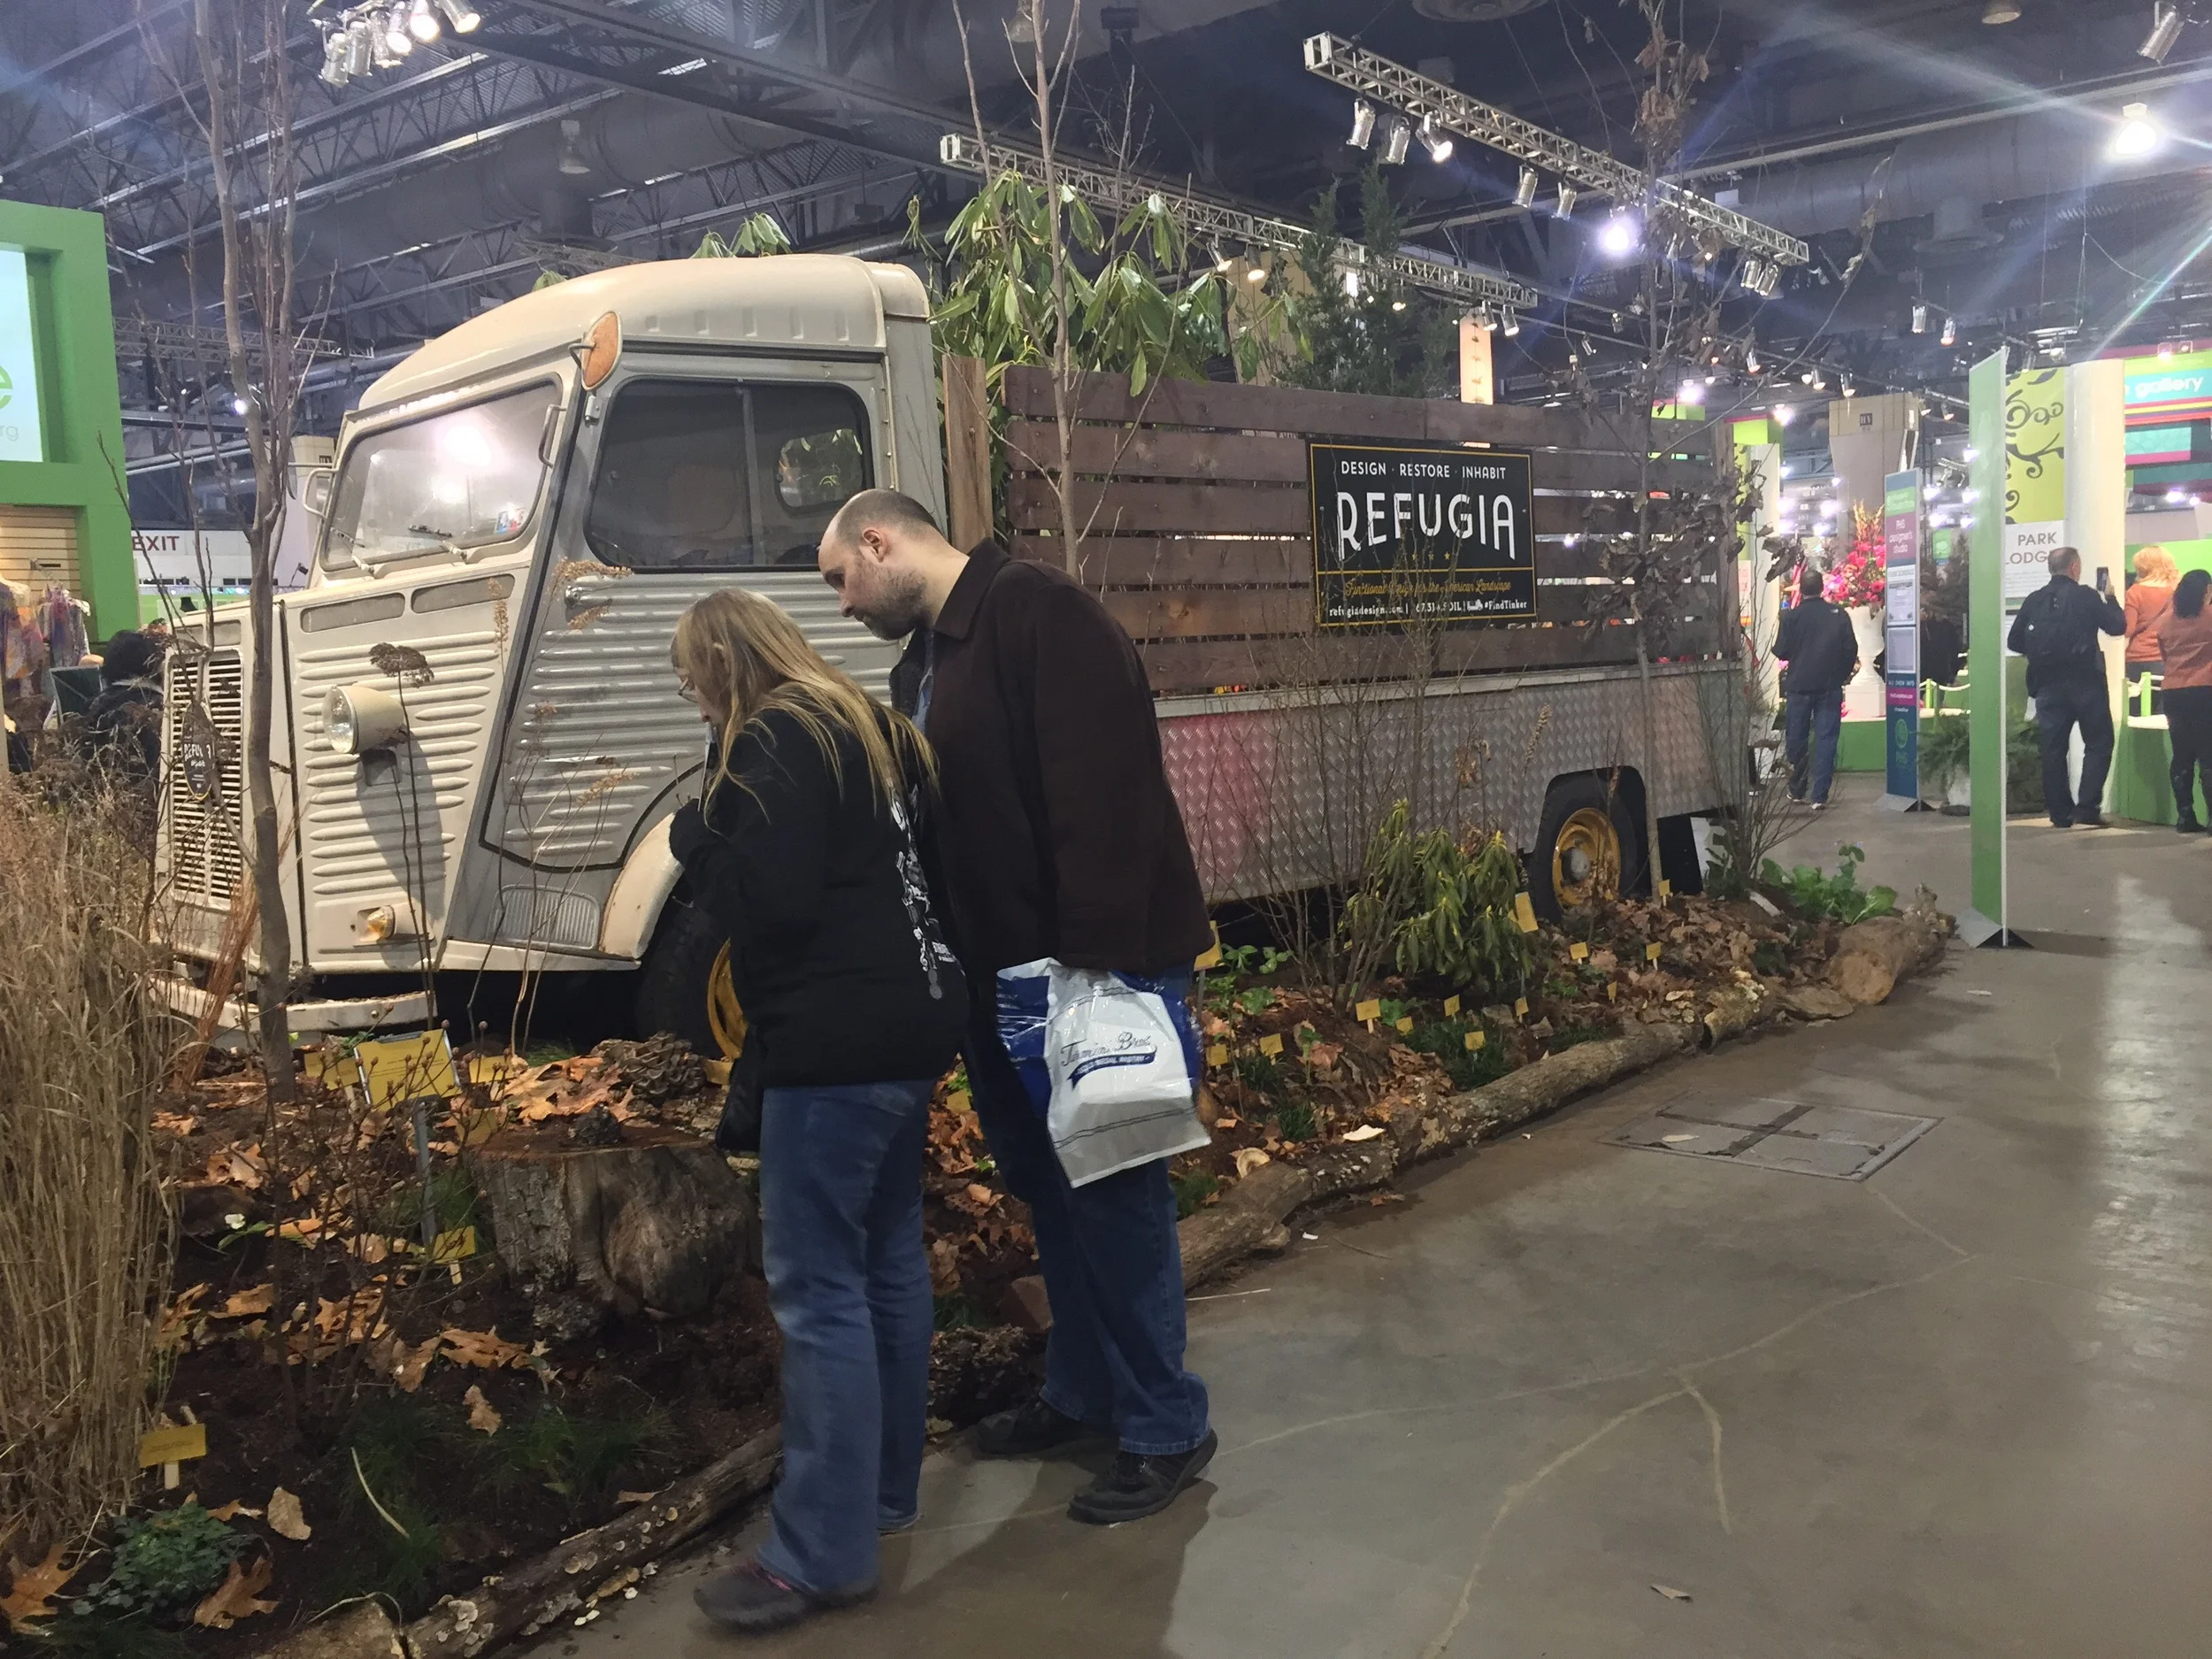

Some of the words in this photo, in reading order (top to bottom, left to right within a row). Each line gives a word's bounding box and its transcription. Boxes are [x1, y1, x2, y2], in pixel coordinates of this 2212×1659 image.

[2135, 376, 2203, 399] gallery
[1340, 460, 1386, 476] DESIGN
[1399, 463, 1450, 478] RESTORE
[1462, 465, 1506, 480] INHABIT
[1337, 491, 1516, 561] REFUGIA
[132, 535, 180, 551] EXIT
[2017, 532, 2057, 546] PARK
[2005, 550, 2048, 565] ODG
[183, 742, 212, 763] REFUA
